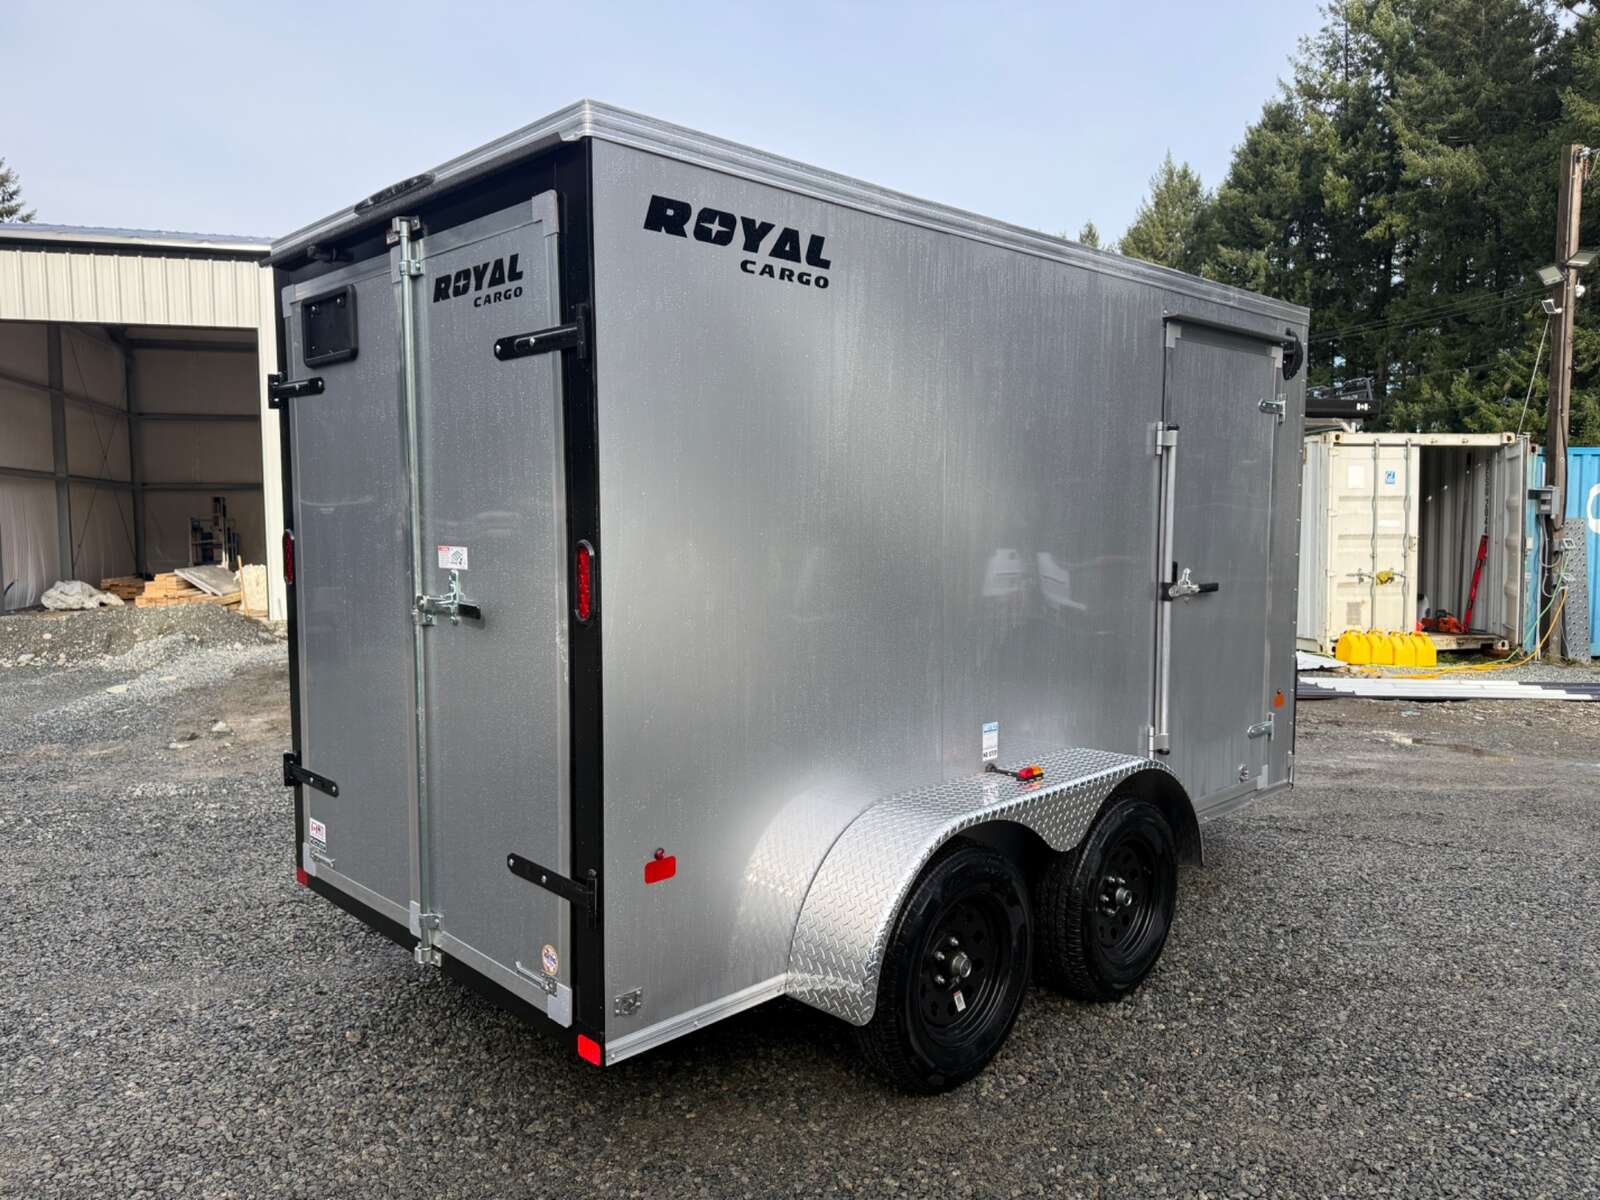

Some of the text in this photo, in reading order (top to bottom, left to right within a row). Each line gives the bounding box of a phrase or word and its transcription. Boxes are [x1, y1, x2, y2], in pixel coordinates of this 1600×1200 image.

[643, 194, 831, 270] ROYAL
[432, 253, 523, 303] ROYAL
[740, 259, 829, 289] CARGO
[474, 286, 523, 308] CARGO
